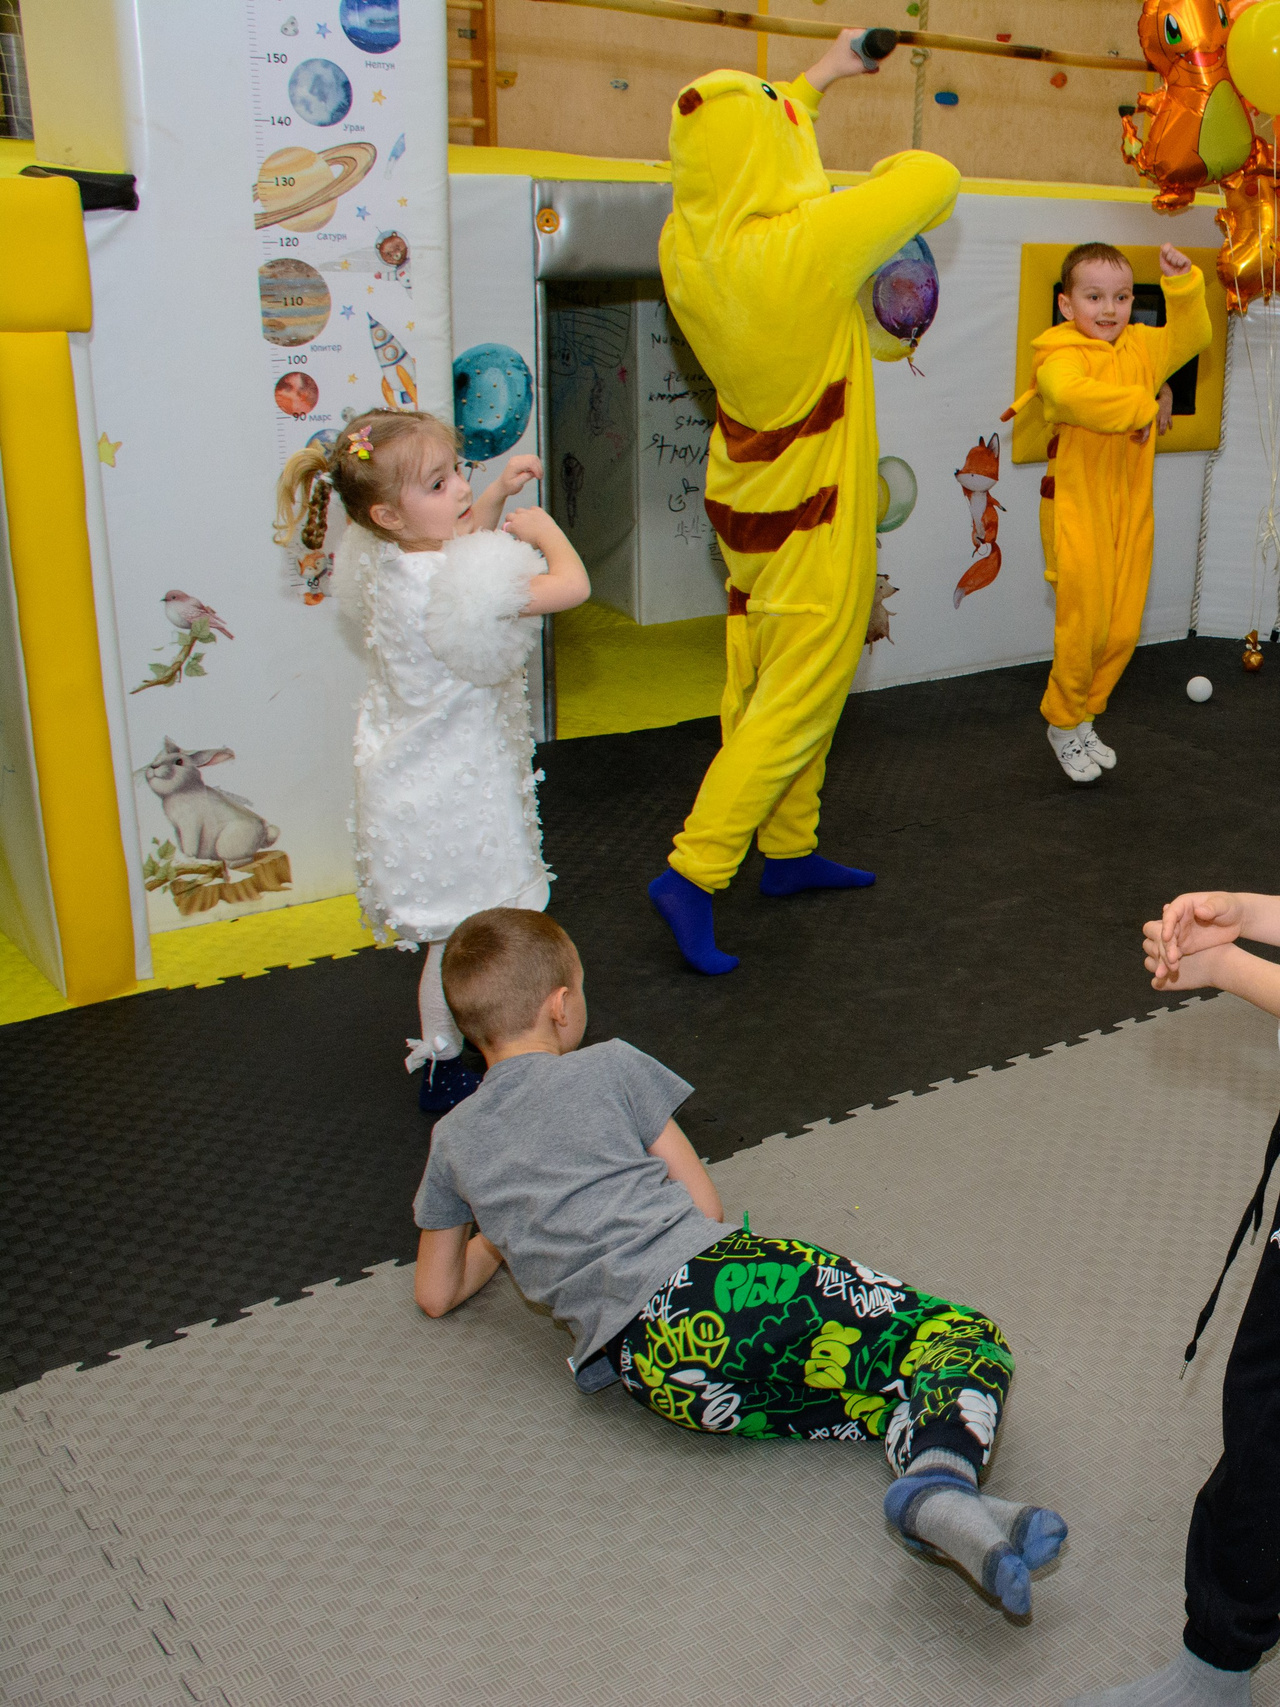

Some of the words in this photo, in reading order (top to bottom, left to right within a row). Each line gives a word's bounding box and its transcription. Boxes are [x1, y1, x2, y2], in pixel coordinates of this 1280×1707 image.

[266, 53, 288, 64] 150
[365, 60, 396, 71] Нептун
[270, 116, 292, 127] 140
[343, 124, 366, 134] Уран
[274, 177, 296, 187] 130
[279, 237, 300, 247] 120
[316, 232, 348, 243] Сатурн
[282, 296, 304, 307] 110
[309, 343, 343, 354] Юпитер
[287, 354, 308, 365] 100
[292, 411, 307, 422] 90
[308, 412, 332, 423] Марс
